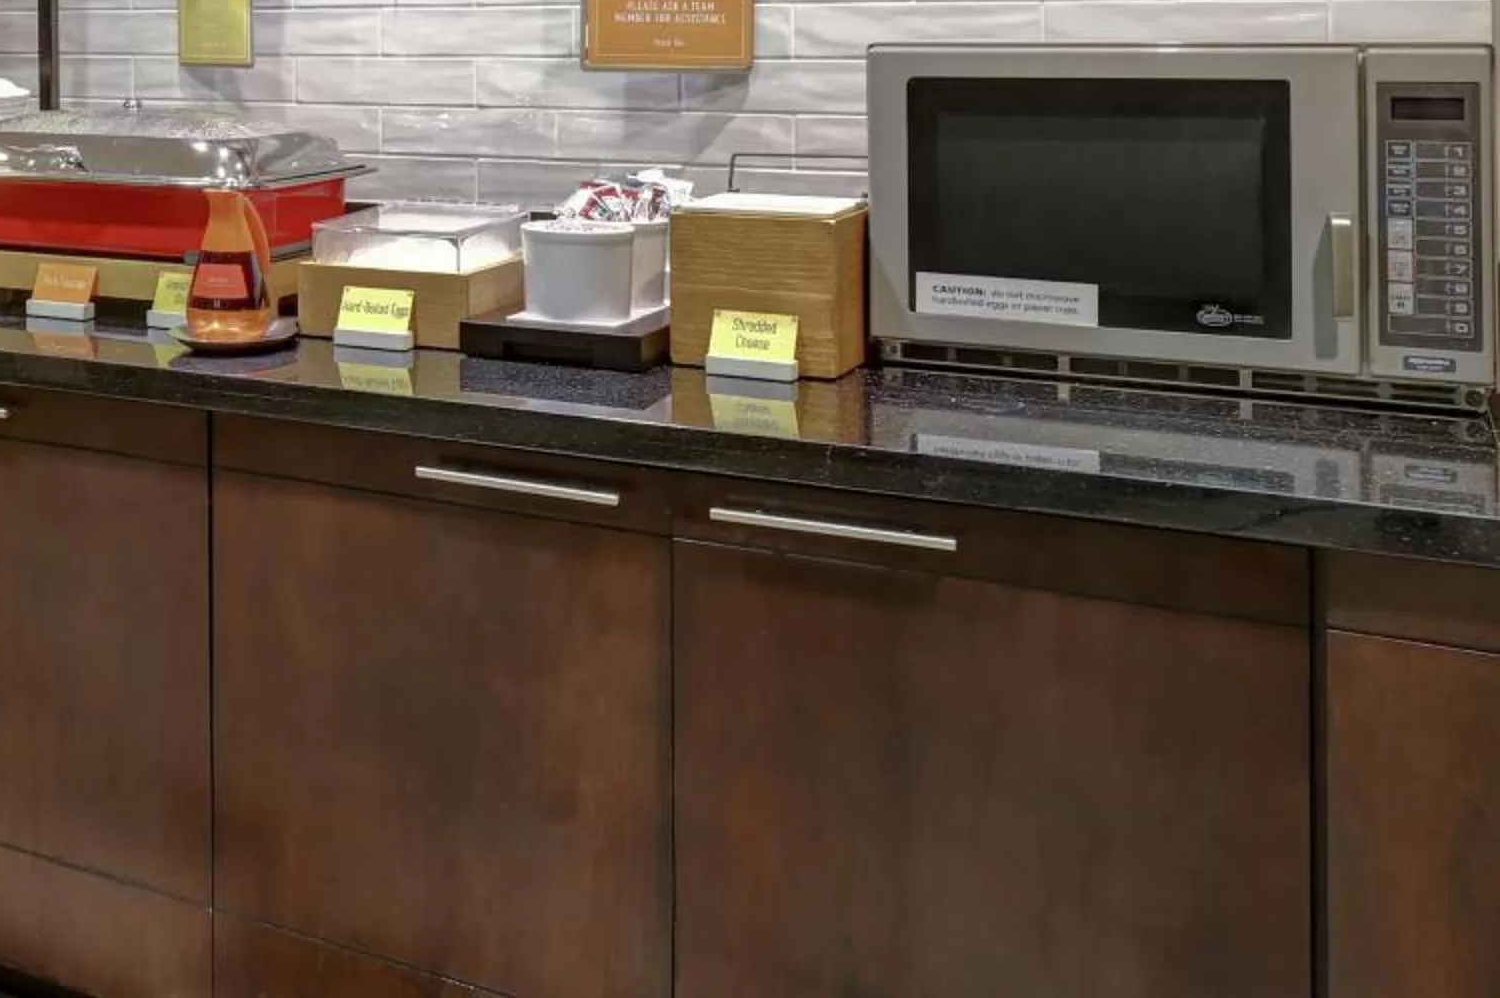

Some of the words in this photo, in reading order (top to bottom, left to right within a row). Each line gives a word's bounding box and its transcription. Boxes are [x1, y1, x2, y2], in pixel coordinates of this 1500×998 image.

[691, 1, 715, 11] TEAM
[613, 12, 651, 23] MEMBER
[932, 285, 986, 296] CAUTION:
[732, 317, 777, 334] Shredded
